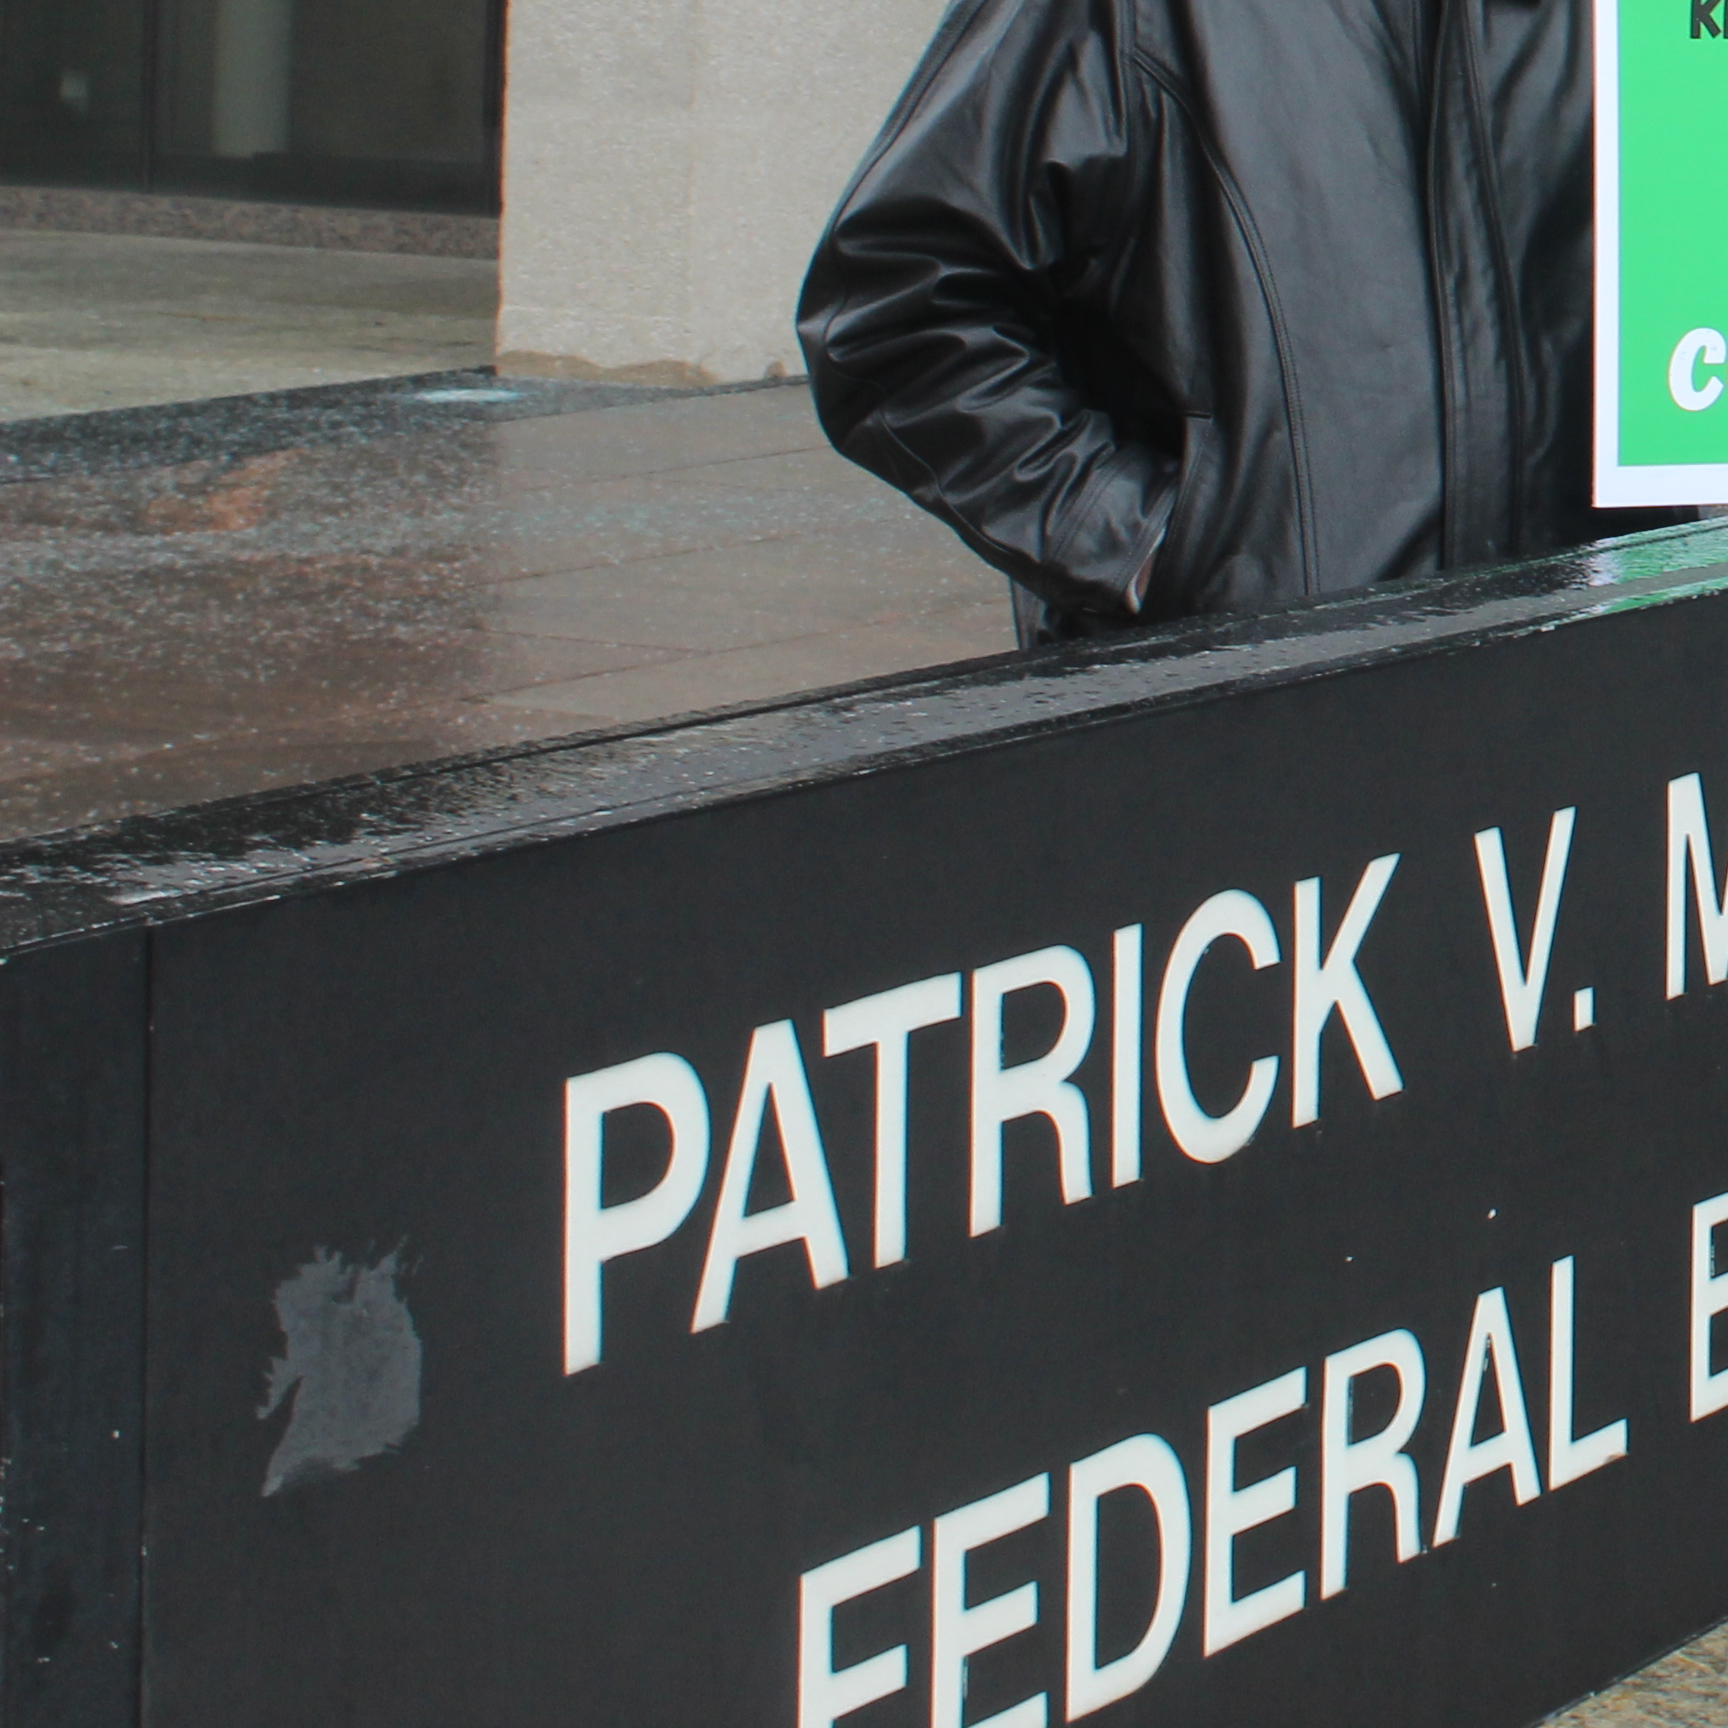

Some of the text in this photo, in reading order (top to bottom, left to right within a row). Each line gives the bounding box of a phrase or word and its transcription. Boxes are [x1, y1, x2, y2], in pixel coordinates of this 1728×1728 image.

[564, 854, 1403, 1376] PATRICK
[1475, 807, 1593, 1052] V.
[797, 1257, 1628, 1728] FEDERAL
